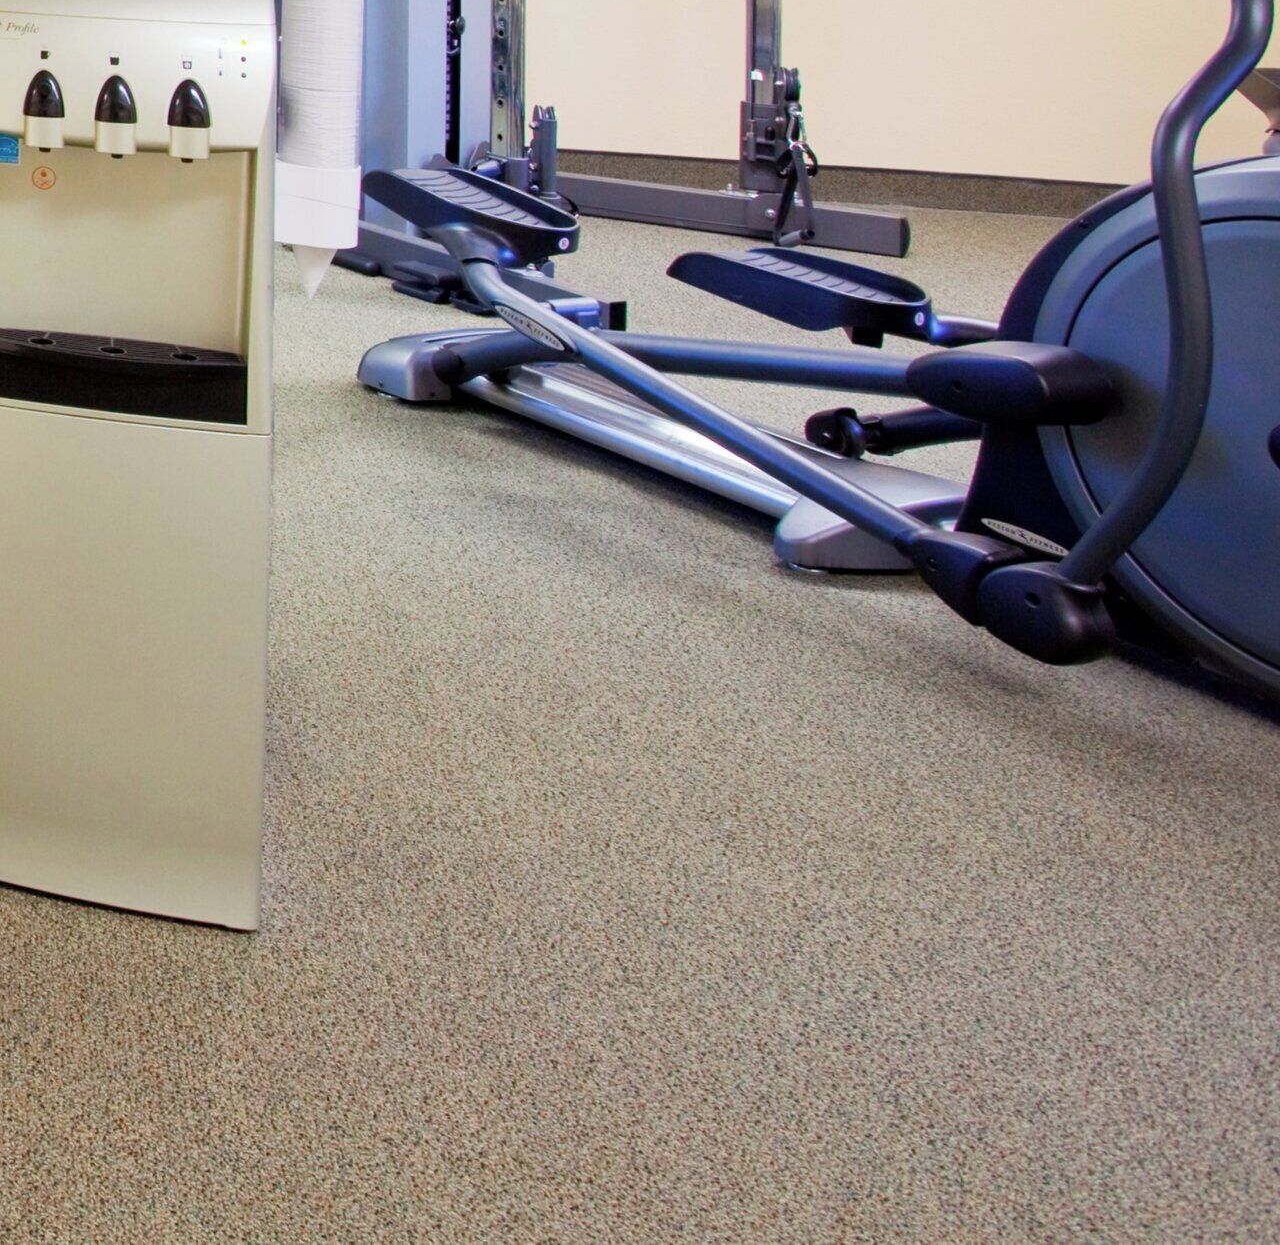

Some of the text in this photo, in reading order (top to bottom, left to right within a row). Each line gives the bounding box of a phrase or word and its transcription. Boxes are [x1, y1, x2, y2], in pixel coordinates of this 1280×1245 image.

[7, 22, 40, 35] Profile
[500, 307, 523, 324] VISION
[987, 521, 1064, 553] VISION FITNESS
